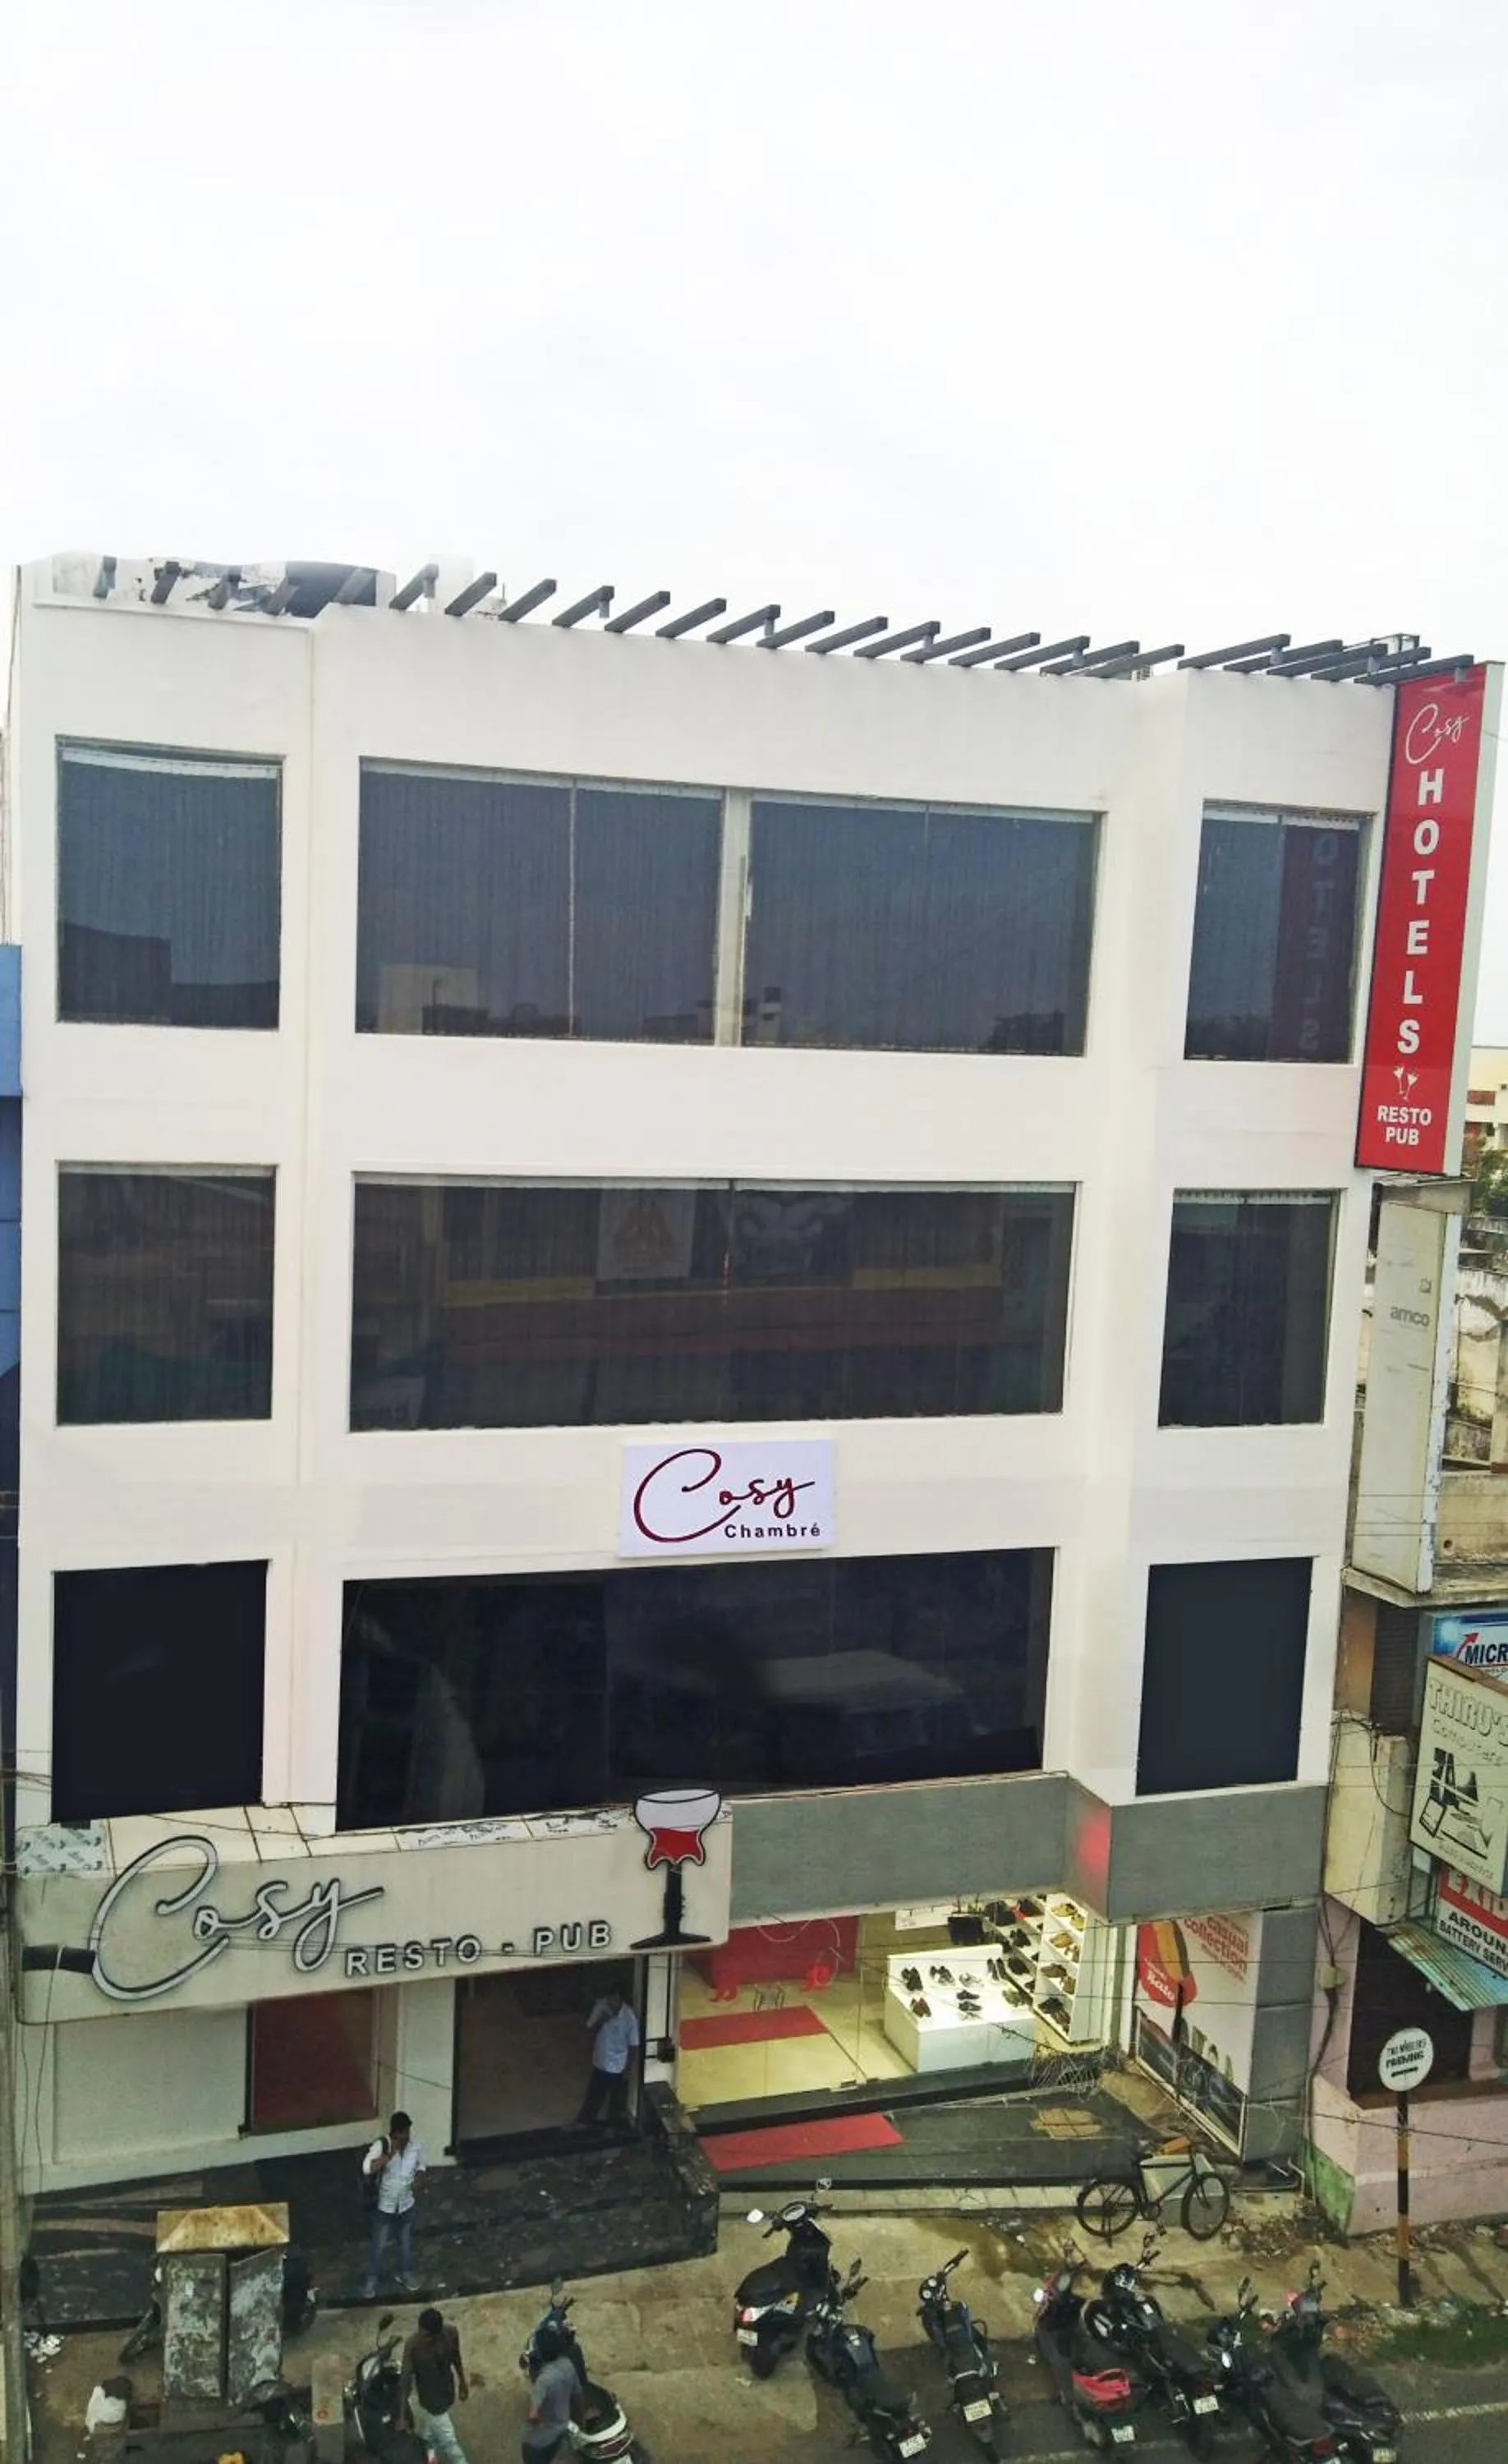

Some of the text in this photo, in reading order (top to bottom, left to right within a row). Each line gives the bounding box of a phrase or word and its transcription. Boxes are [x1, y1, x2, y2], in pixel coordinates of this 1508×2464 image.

[1405, 702, 1470, 765] Cosy
[1396, 767, 1445, 1054] HOTELS
[1377, 1104, 1432, 1126] RESTO
[1385, 1126, 1420, 1147] PUB
[1390, 1307, 1430, 1327] amco
[633, 1447, 816, 1543] Cosy
[724, 1522, 821, 1538] Chambré
[89, 1834, 384, 2002] Cosy
[1439, 1919, 1481, 1953] BATTERY
[344, 1933, 482, 1977] RESTO
[533, 1919, 612, 1956] PUB
